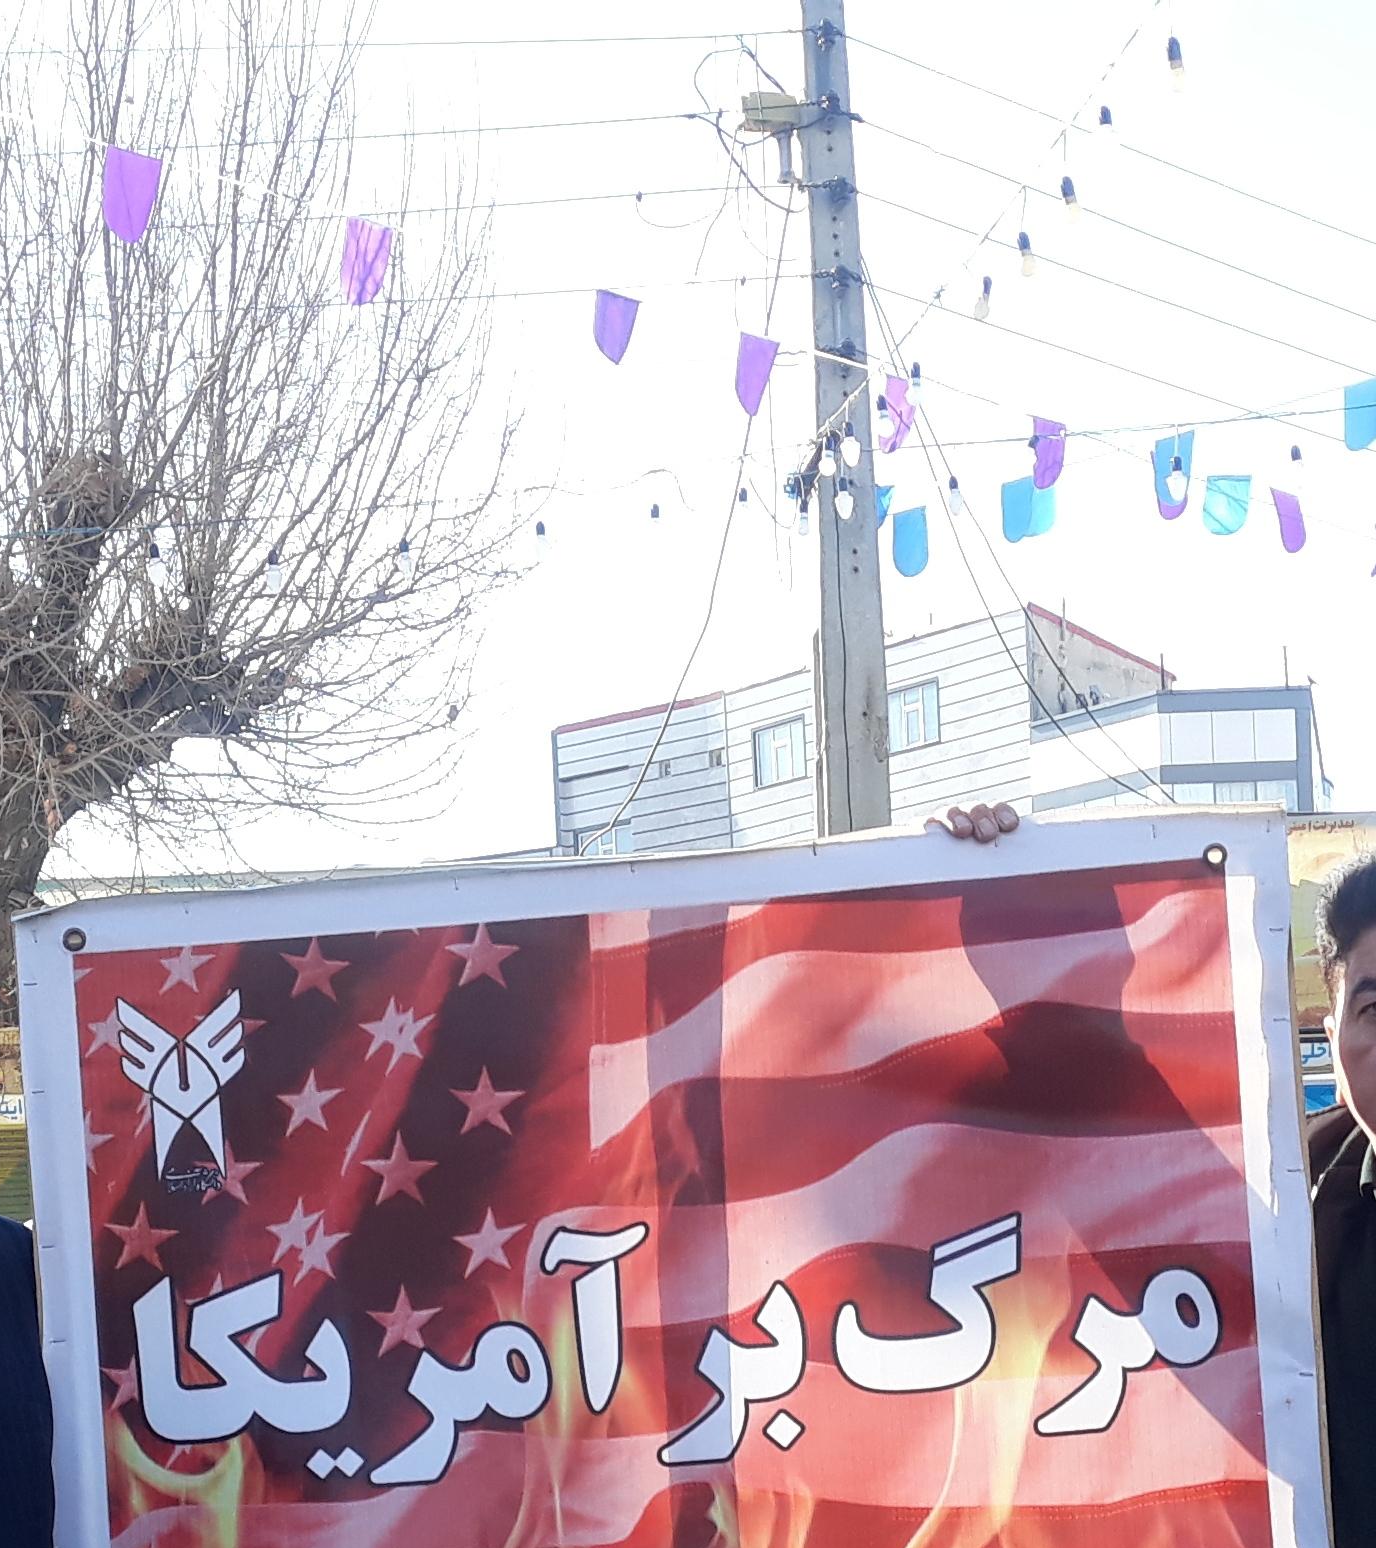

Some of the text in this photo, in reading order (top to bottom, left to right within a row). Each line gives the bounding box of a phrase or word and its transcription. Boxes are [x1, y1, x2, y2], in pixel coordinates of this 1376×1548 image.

[130, 1211, 1222, 1486] مرگ بر آمریکا
